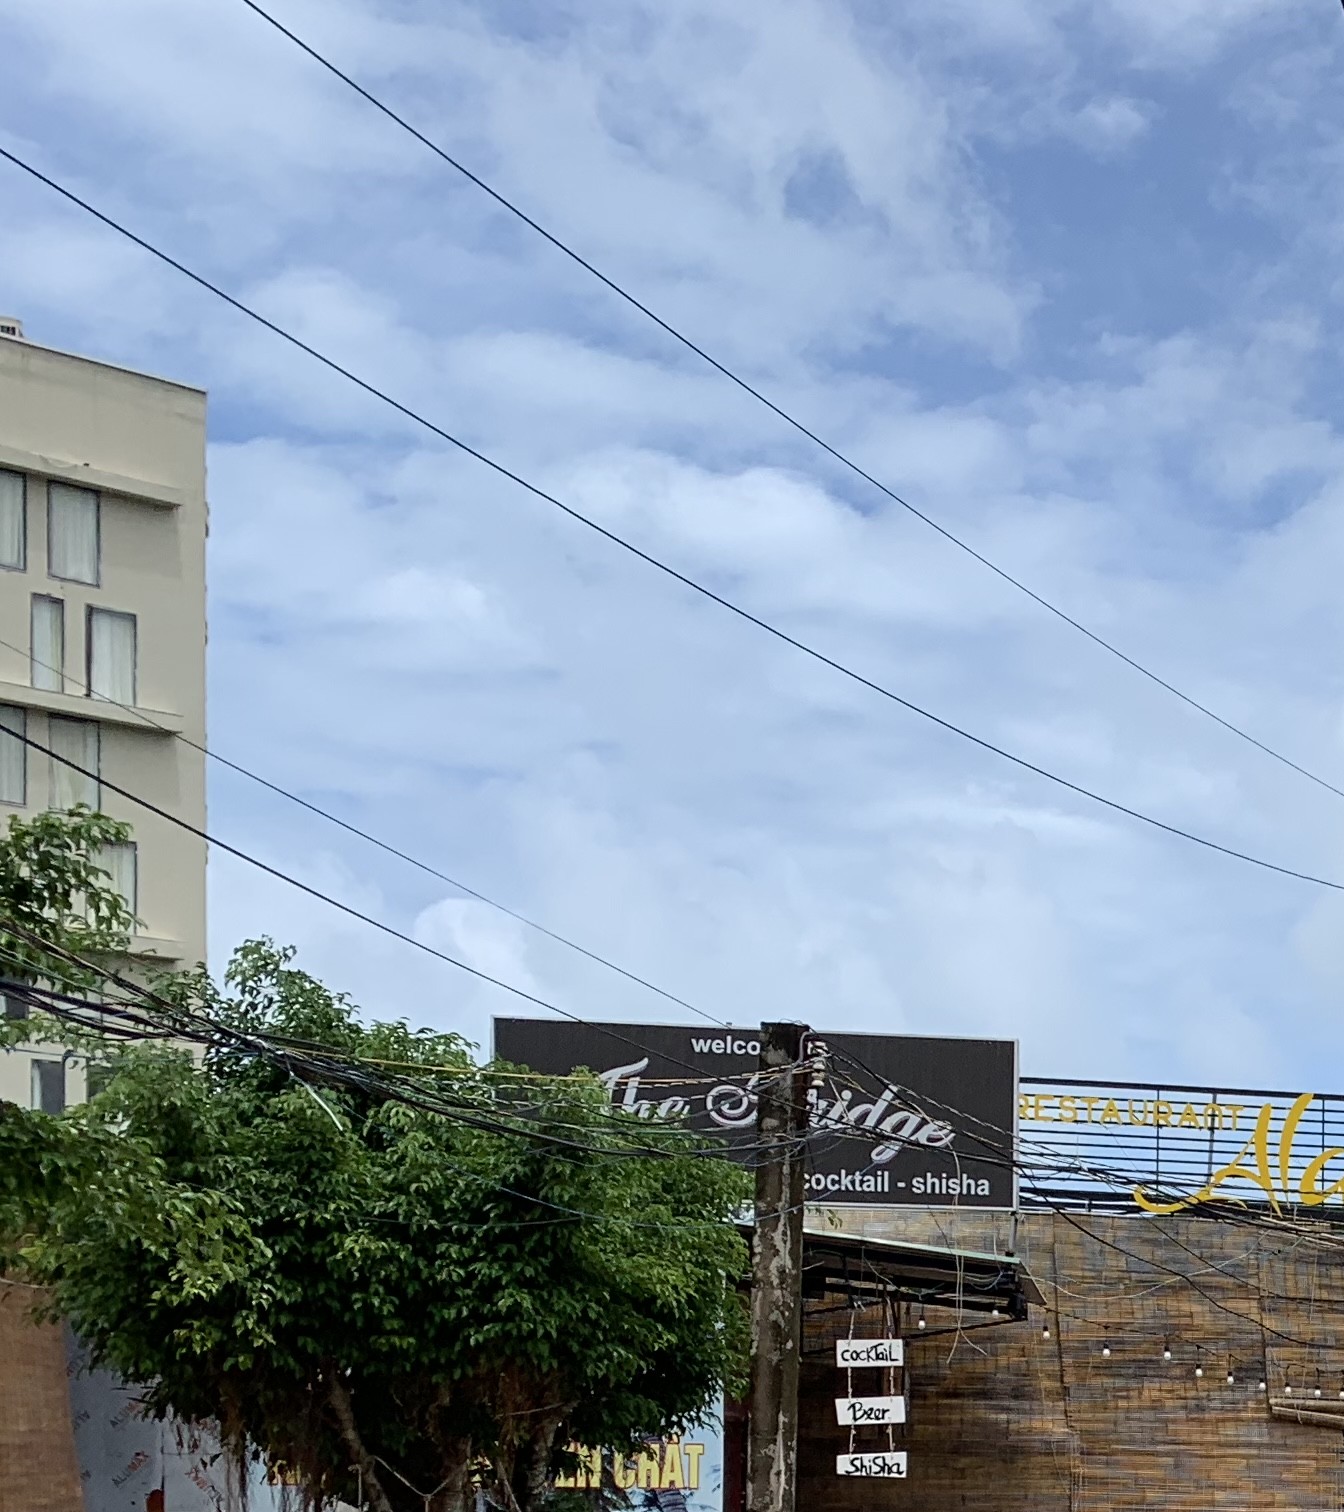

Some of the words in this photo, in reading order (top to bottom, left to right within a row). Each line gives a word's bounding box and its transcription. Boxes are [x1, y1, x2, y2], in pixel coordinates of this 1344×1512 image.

[691, 1036, 761, 1055] welco
[911, 1172, 990, 1196] shisha
[847, 1401, 891, 1422] Beer
